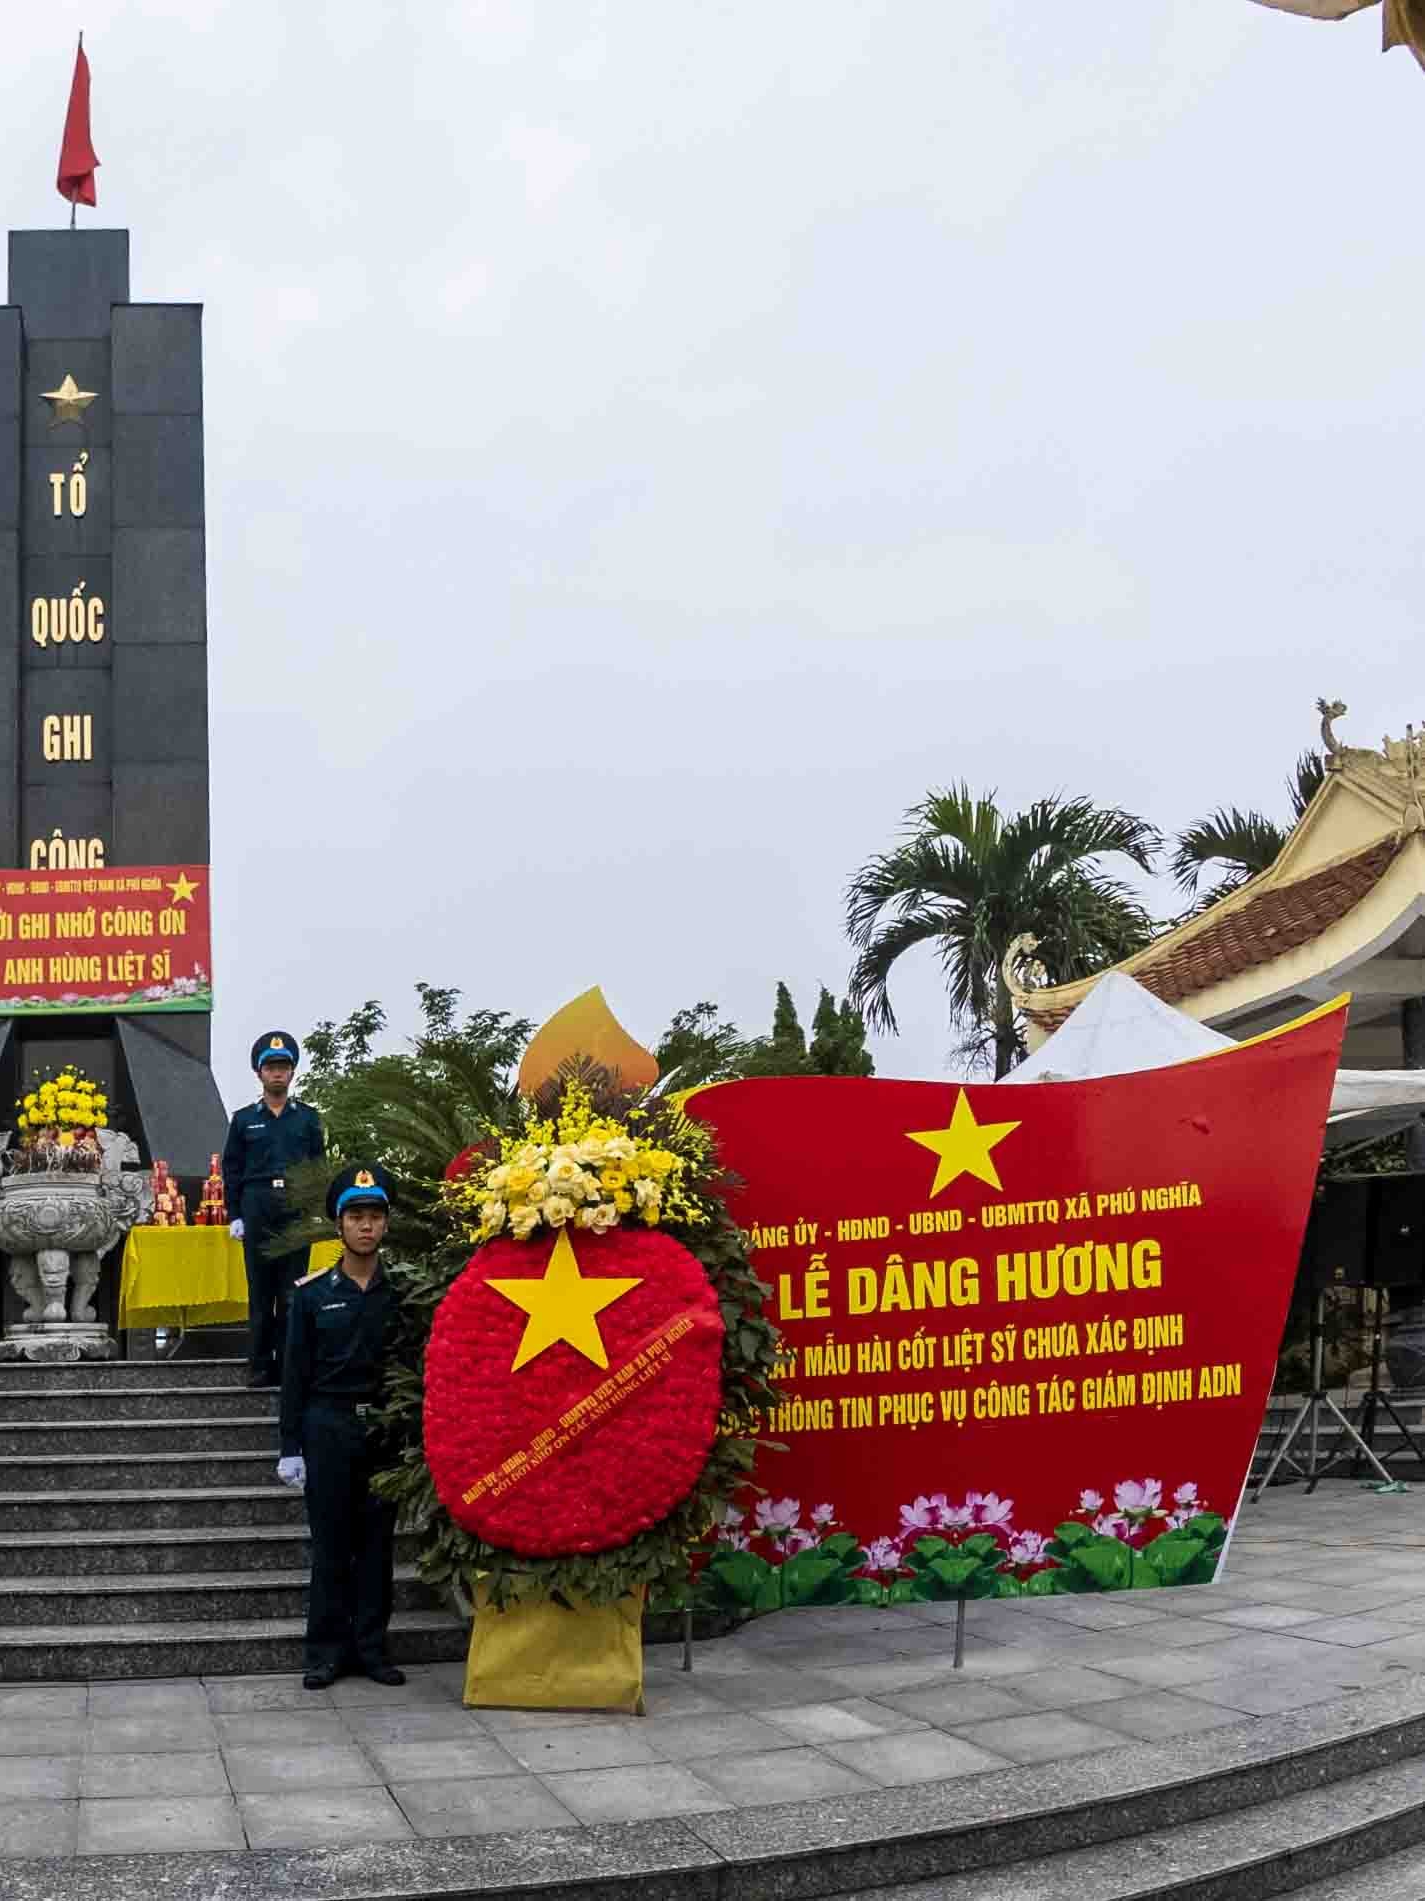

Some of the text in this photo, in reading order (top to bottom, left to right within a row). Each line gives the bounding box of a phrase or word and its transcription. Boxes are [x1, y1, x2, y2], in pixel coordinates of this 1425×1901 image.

[50, 453, 87, 515] TỔ
[33, 582, 103, 646] QUỐC
[44, 716, 91, 760] GHI
[31, 829, 103, 870] CÔNG
[19, 913, 50, 939] GHI
[56, 906, 95, 938] NHỚ
[101, 906, 153, 936] CÔNG
[159, 904, 185, 935] ƠN
[4, 958, 43, 984] ANH
[49, 952, 101, 982] HÙNG
[107, 949, 146, 987] LIỆT
[152, 950, 170, 980] SĨ
[794, 1217, 818, 1245] ỦY
[838, 1216, 889, 1241] HĐND
[910, 1210, 962, 1235] UBND
[982, 1200, 1059, 1228] UBMTTQ
[1065, 1192, 1091, 1220] XÃ
[1097, 1187, 1135, 1216] PHÚ
[1142, 1181, 1202, 1211] NGHĨA
[779, 1240, 1161, 1320] LỄ DÂNG HƯƠNG
[767, 1314, 1183, 1380] ẤY MẪU HÀI CỐT LIỆT SỸ CHƯA XÁC ĐỊNH
[840, 1397, 872, 1428] TIN
[879, 1392, 934, 1430] PHỤC
[940, 1389, 966, 1427] VỤ
[974, 1380, 1030, 1419] CÔNG
[1036, 1375, 1075, 1414] TÁC
[1082, 1369, 1136, 1410] GIÁM
[1142, 1368, 1192, 1410] ĐỊNH
[1198, 1363, 1241, 1399] ADN
